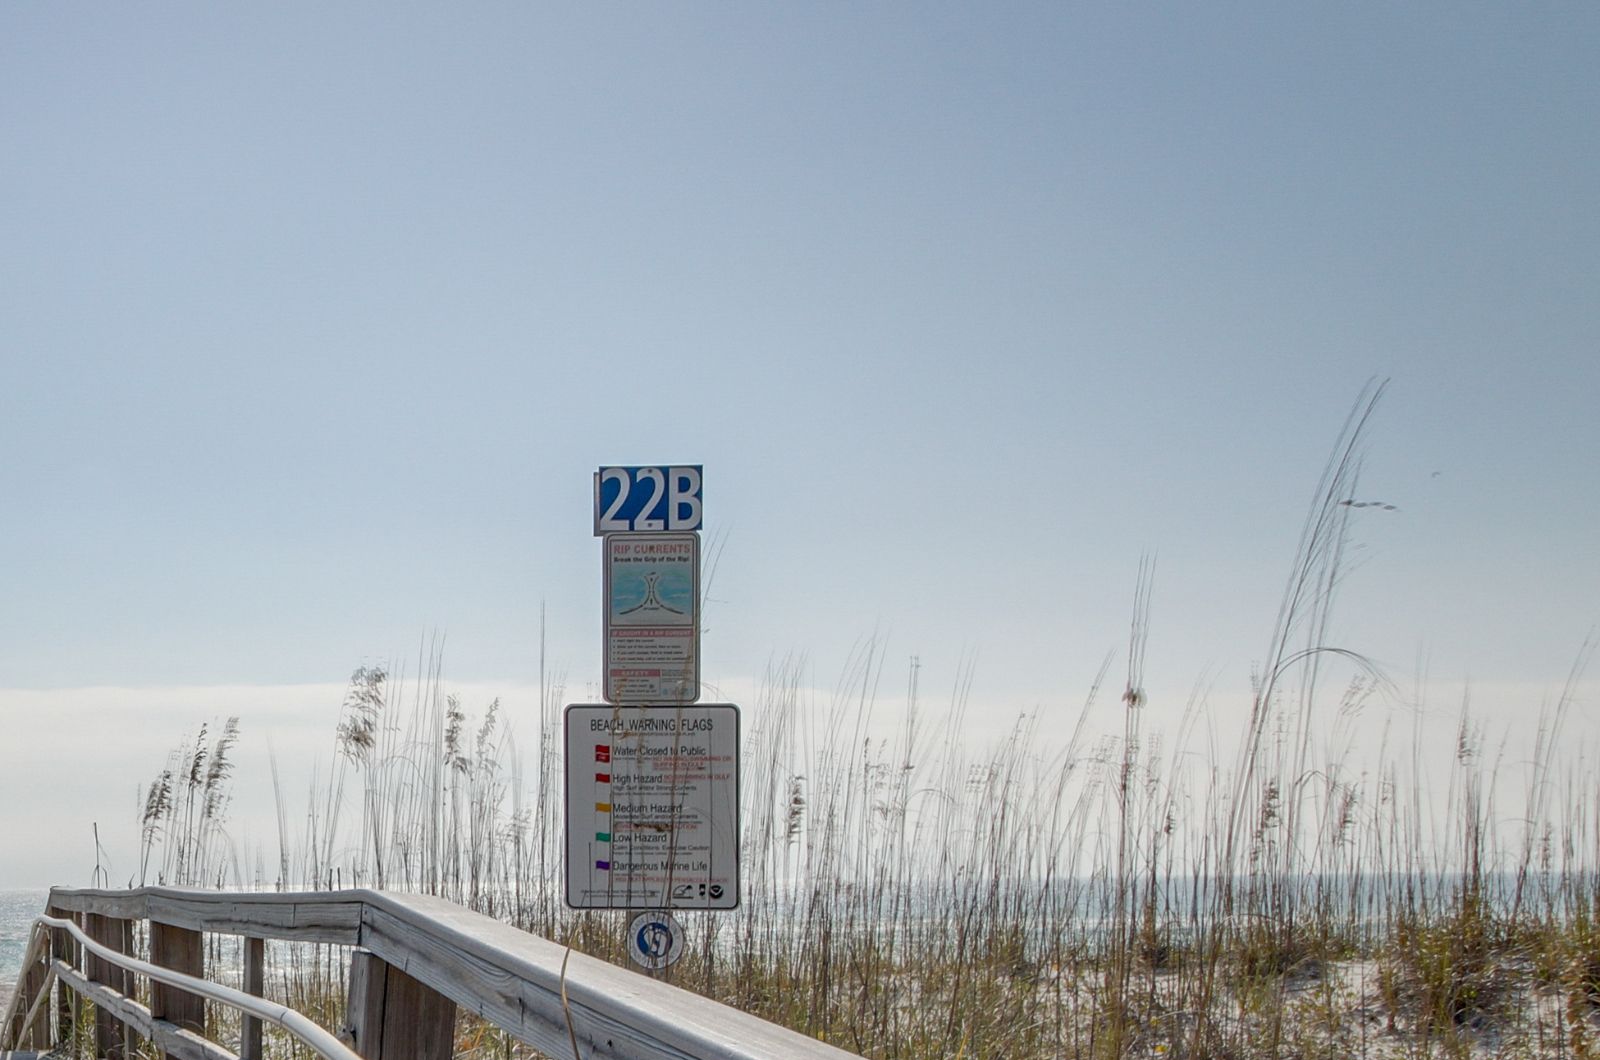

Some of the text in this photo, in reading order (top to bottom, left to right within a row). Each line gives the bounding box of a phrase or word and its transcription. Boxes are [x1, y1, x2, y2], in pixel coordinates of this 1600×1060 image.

[600, 467, 702, 531] 22B
[614, 544, 691, 554] RIP CURRENTS
[644, 556, 657, 564] Grip
[590, 719, 713, 731] BEACH WARNING FLAGS
[613, 746, 706, 756] Water Closed to Public
[613, 774, 663, 785] High Hazard
[613, 803, 682, 813] Medium Hazard
[613, 833, 667, 842] Low Hazard
[613, 861, 659, 873] Dangerous
[691, 861, 708, 871] Life
